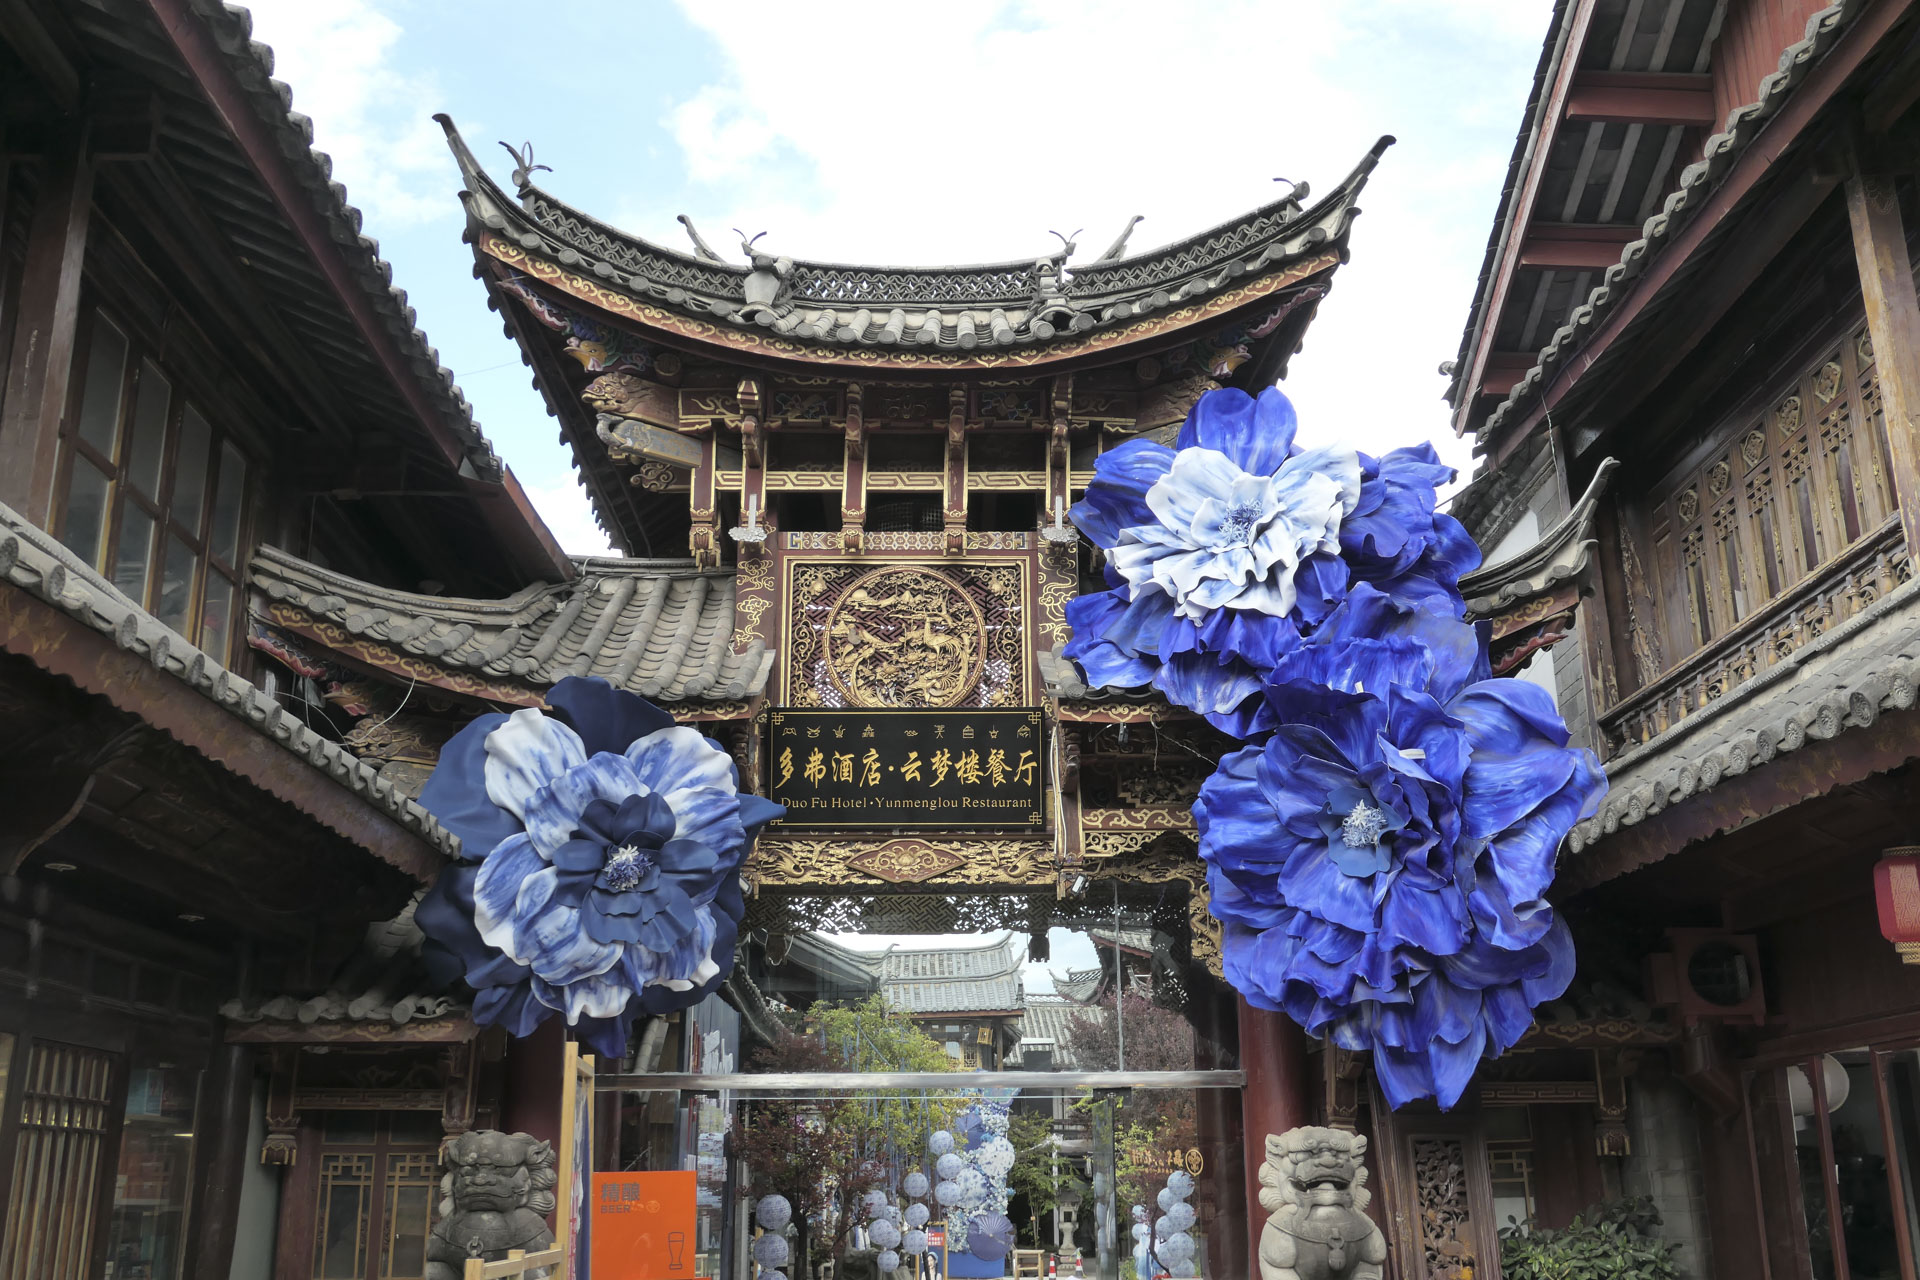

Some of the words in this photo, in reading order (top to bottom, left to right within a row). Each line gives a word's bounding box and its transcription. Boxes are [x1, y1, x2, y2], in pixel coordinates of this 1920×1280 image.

[781, 797, 808, 809] Duo
[811, 797, 828, 809] Fu
[962, 796, 1032, 808] Restaurant
[600, 1204, 630, 1213] BEER
